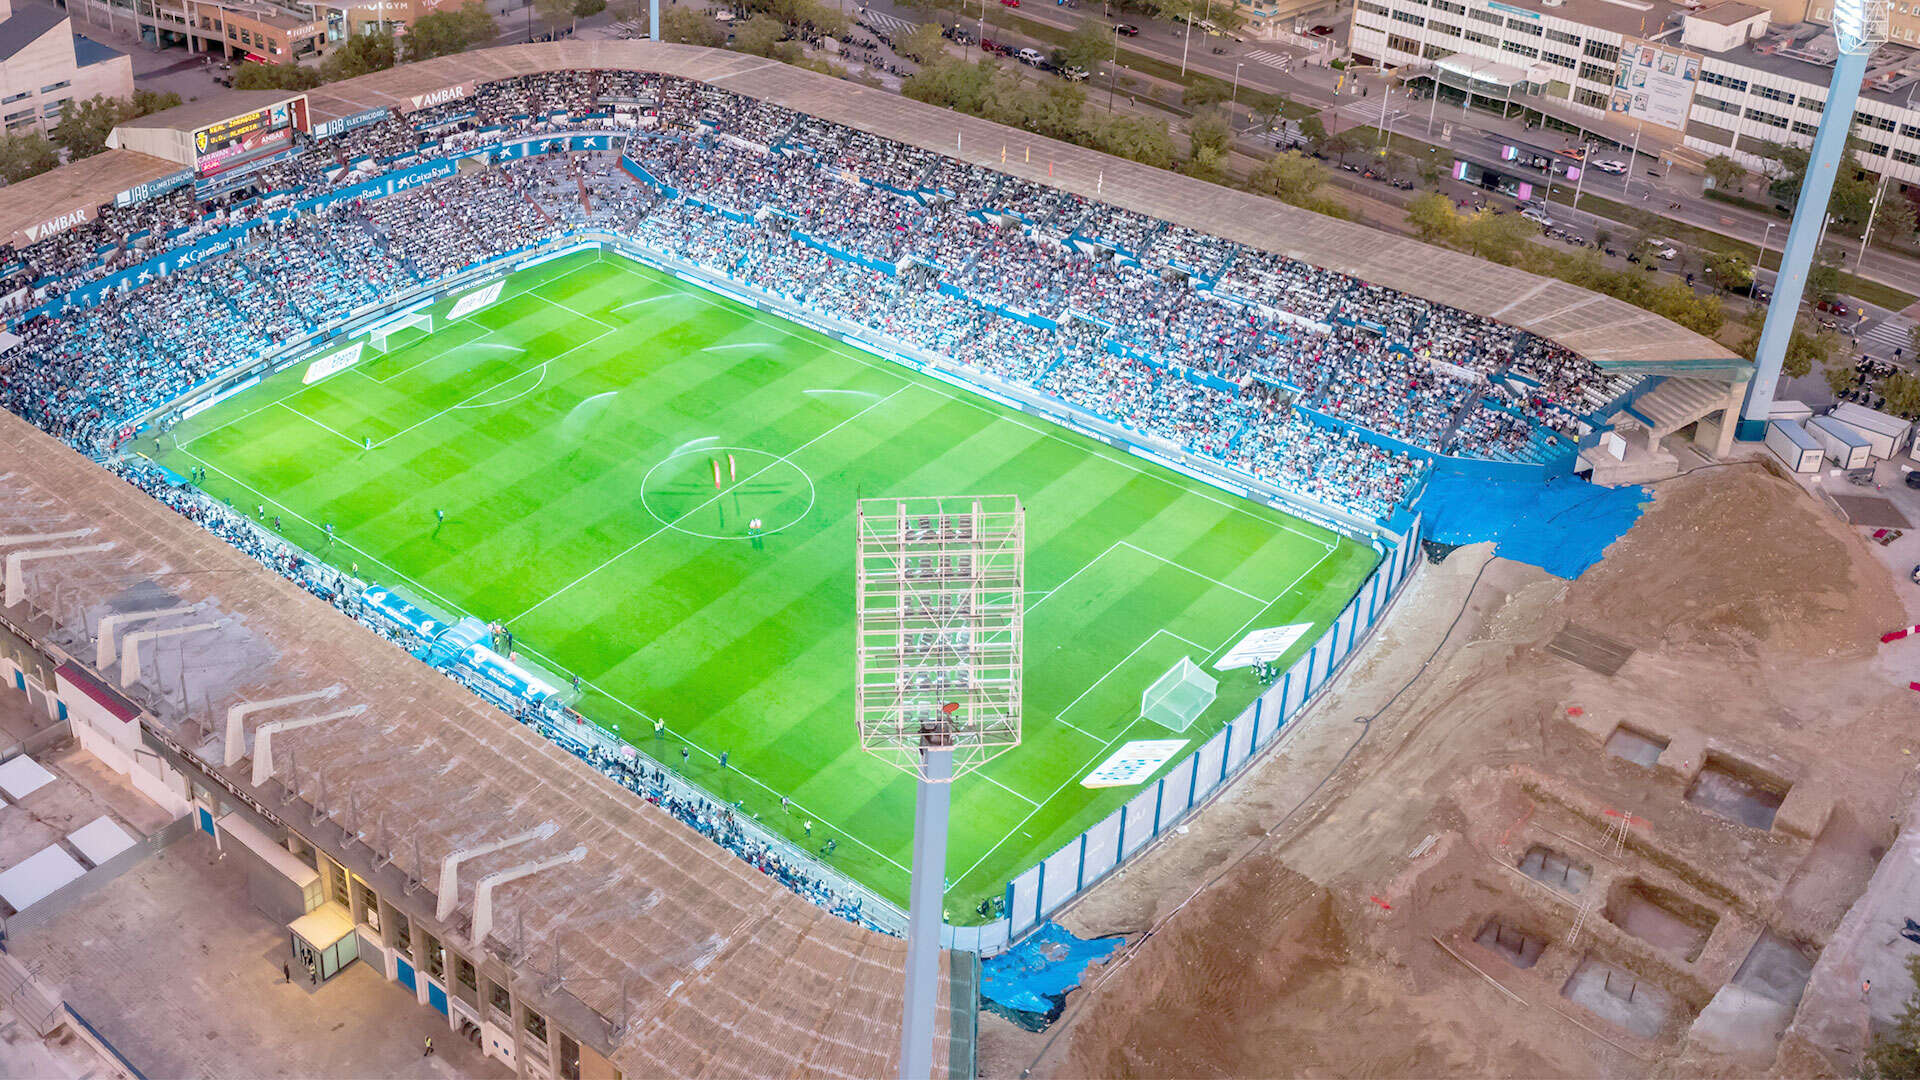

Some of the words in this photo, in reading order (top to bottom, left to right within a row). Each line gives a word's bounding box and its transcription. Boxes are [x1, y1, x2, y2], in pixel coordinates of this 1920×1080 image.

[424, 86, 464, 106] AMBAR
[346, 110, 385, 127] ELECTRICIDAD
[261, 130, 284, 144] AMBAR
[150, 171, 194, 192] CLIMATIZACIÓN
[409, 164, 451, 184] CaixaBank
[40, 209, 87, 238] AMBAR
